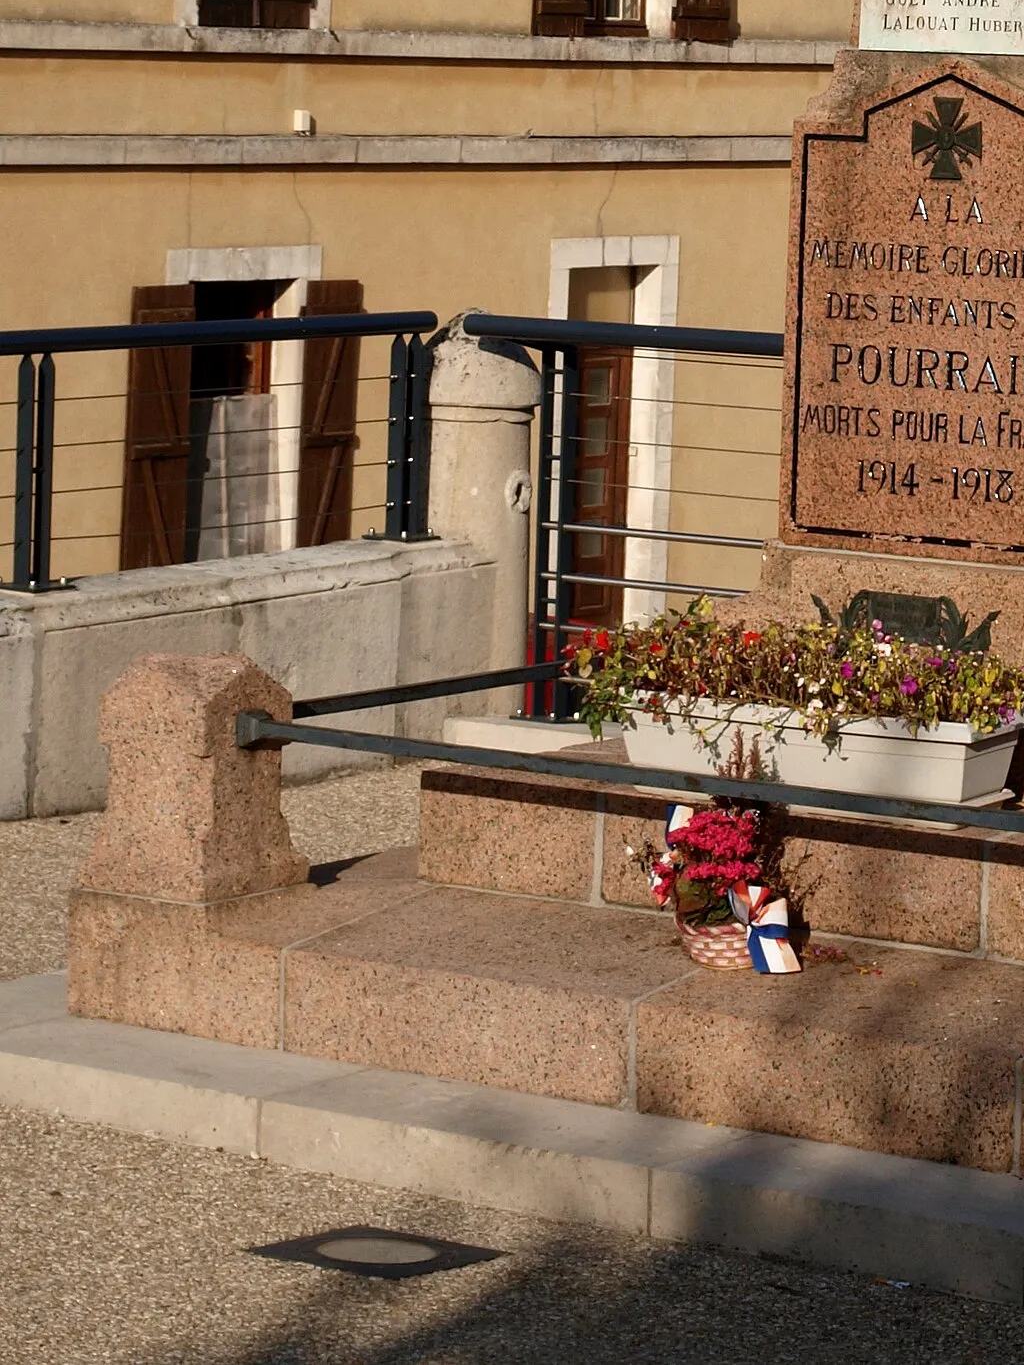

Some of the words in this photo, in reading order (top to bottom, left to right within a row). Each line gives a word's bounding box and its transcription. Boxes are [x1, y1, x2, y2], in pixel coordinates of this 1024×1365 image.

[883, 13, 959, 31] LALOUAT
[910, 195, 928, 222] A
[945, 195, 984, 225] LA
[809, 239, 929, 274] MEMOIRE
[825, 293, 879, 321] DES
[889, 295, 1017, 331] ENFANTS
[802, 404, 880, 437] MORTS
[892, 409, 949, 442] POUR
[959, 414, 986, 446] LA
